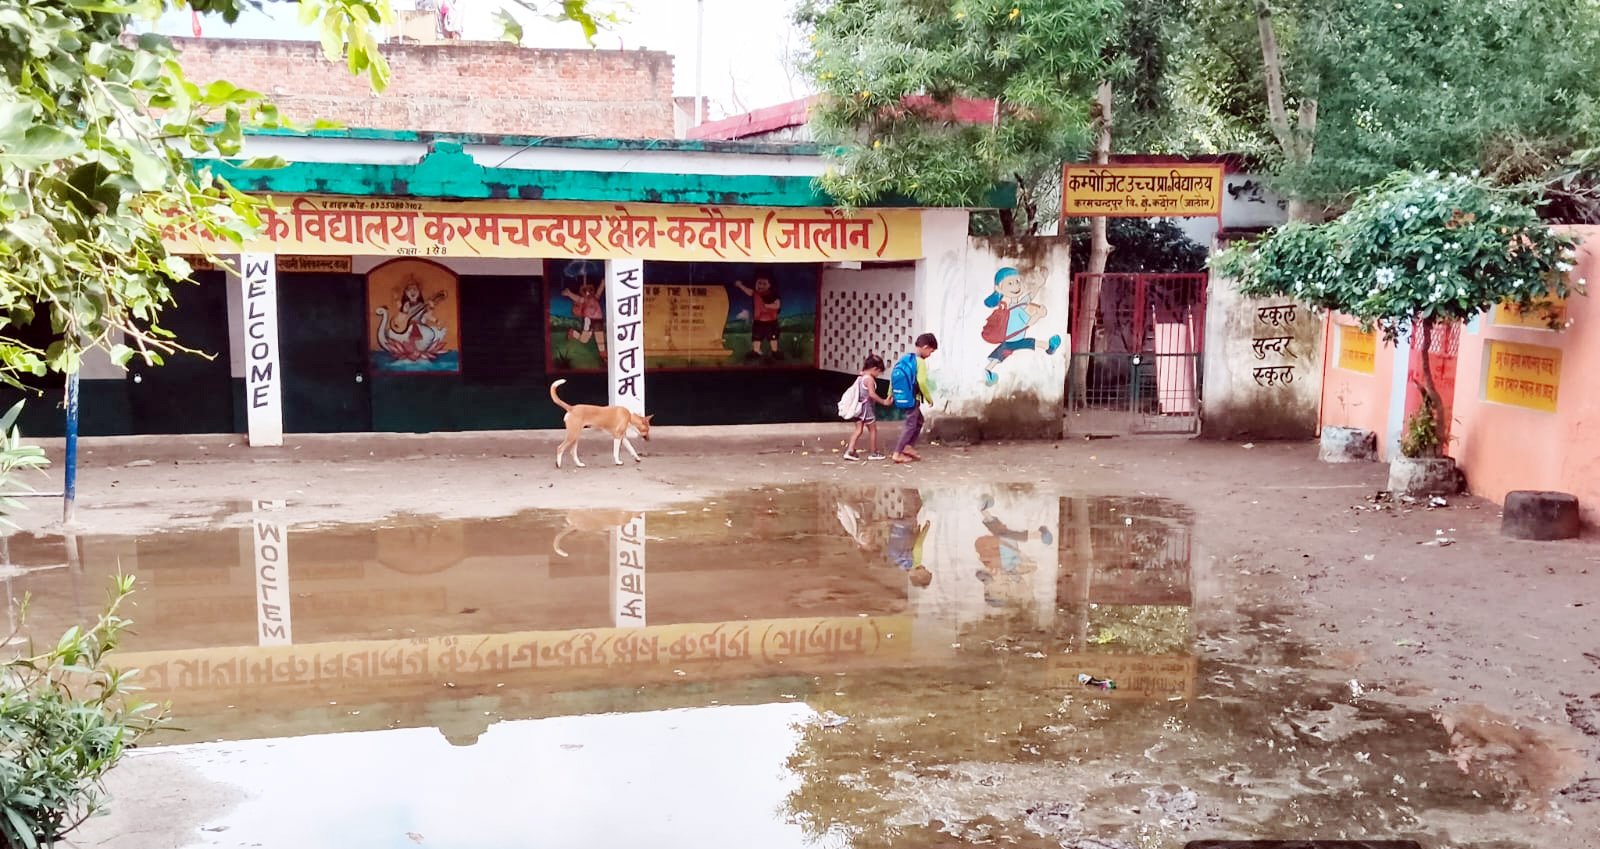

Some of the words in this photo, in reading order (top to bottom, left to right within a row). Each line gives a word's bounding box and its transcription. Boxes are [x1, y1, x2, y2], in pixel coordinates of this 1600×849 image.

[1069, 169, 1125, 192] कम्पोजिट
[1126, 175, 1155, 192] उच्च
[1170, 169, 1213, 195] विद्यालय
[290, 197, 418, 251] विद्यालय
[422, 211, 609, 256] करमचन्दपुर
[762, 208, 889, 258] (जालौन)
[1258, 305, 1297, 326] स्कूल
[246, 260, 273, 409] WELCOME
[1252, 336, 1298, 360] सुन्दर
[1253, 366, 1295, 387] स्कूल
